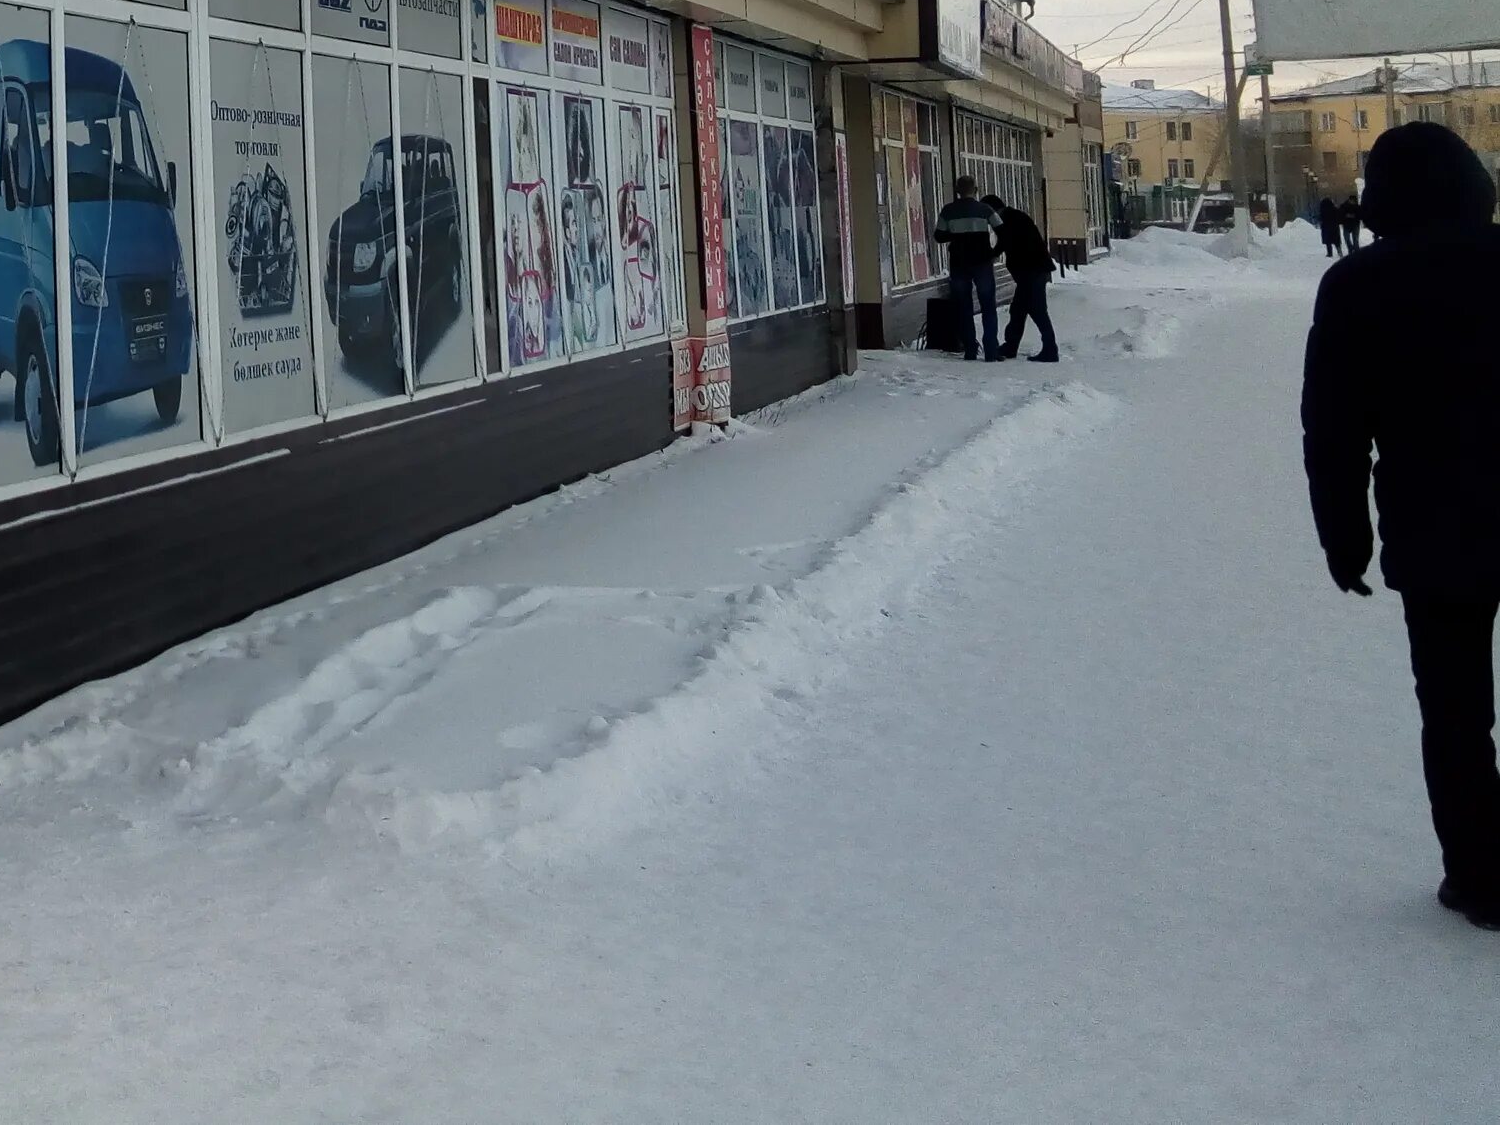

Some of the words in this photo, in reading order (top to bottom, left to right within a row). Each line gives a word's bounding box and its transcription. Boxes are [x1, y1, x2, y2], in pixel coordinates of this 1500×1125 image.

[704, 38, 715, 143] САЛОН
[700, 141, 713, 287] САЛОНЫ
[710, 157, 725, 310] КРАСОТЫ
[275, 357, 302, 379] сауда
